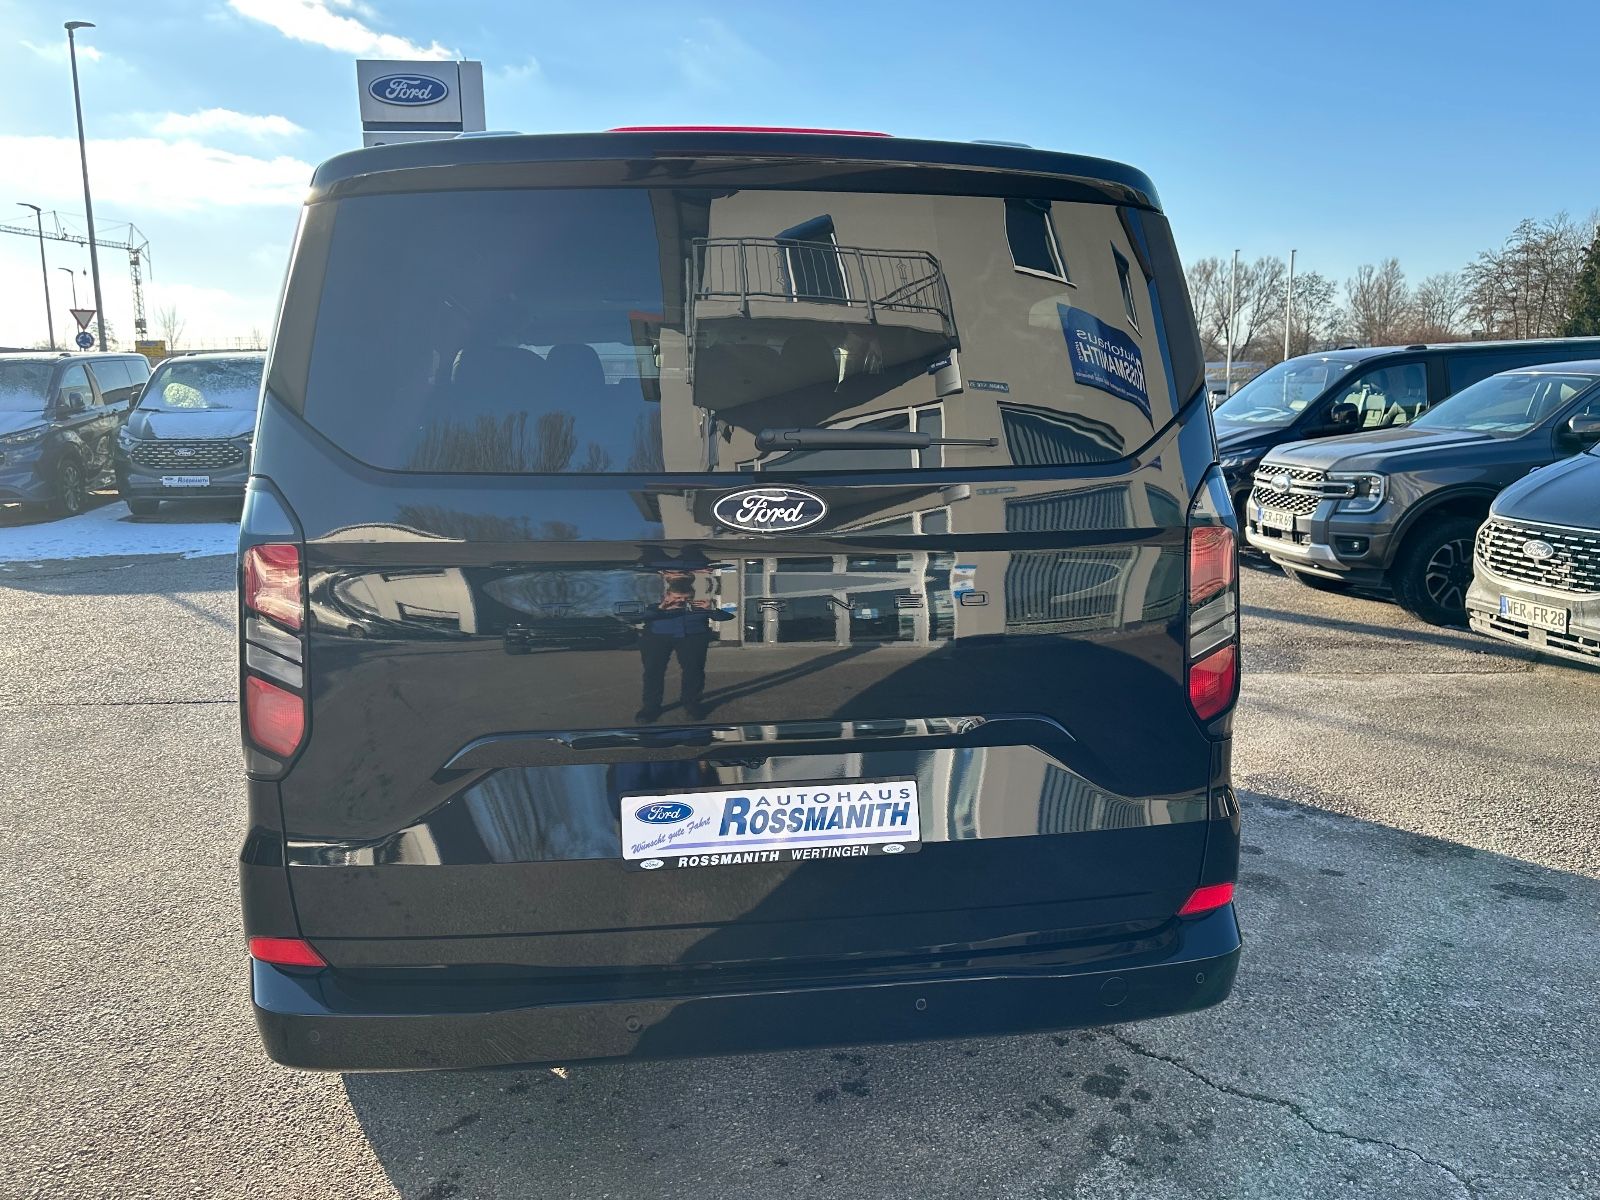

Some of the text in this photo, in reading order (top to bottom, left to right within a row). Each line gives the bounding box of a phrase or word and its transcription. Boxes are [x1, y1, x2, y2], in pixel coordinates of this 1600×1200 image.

[385, 78, 432, 99] Ford
[736, 495, 804, 523] Ford
[1533, 606, 1548, 623] FR
[1550, 610, 1565, 627] 28
[755, 788, 910, 807] AUTOHAUS
[647, 805, 681, 820] Ford
[718, 797, 911, 837] ROSSMANITH
[631, 816, 711, 854] Wünscht gute Fahrt
[678, 845, 869, 868] ROSSMANITH WERTINGEN
